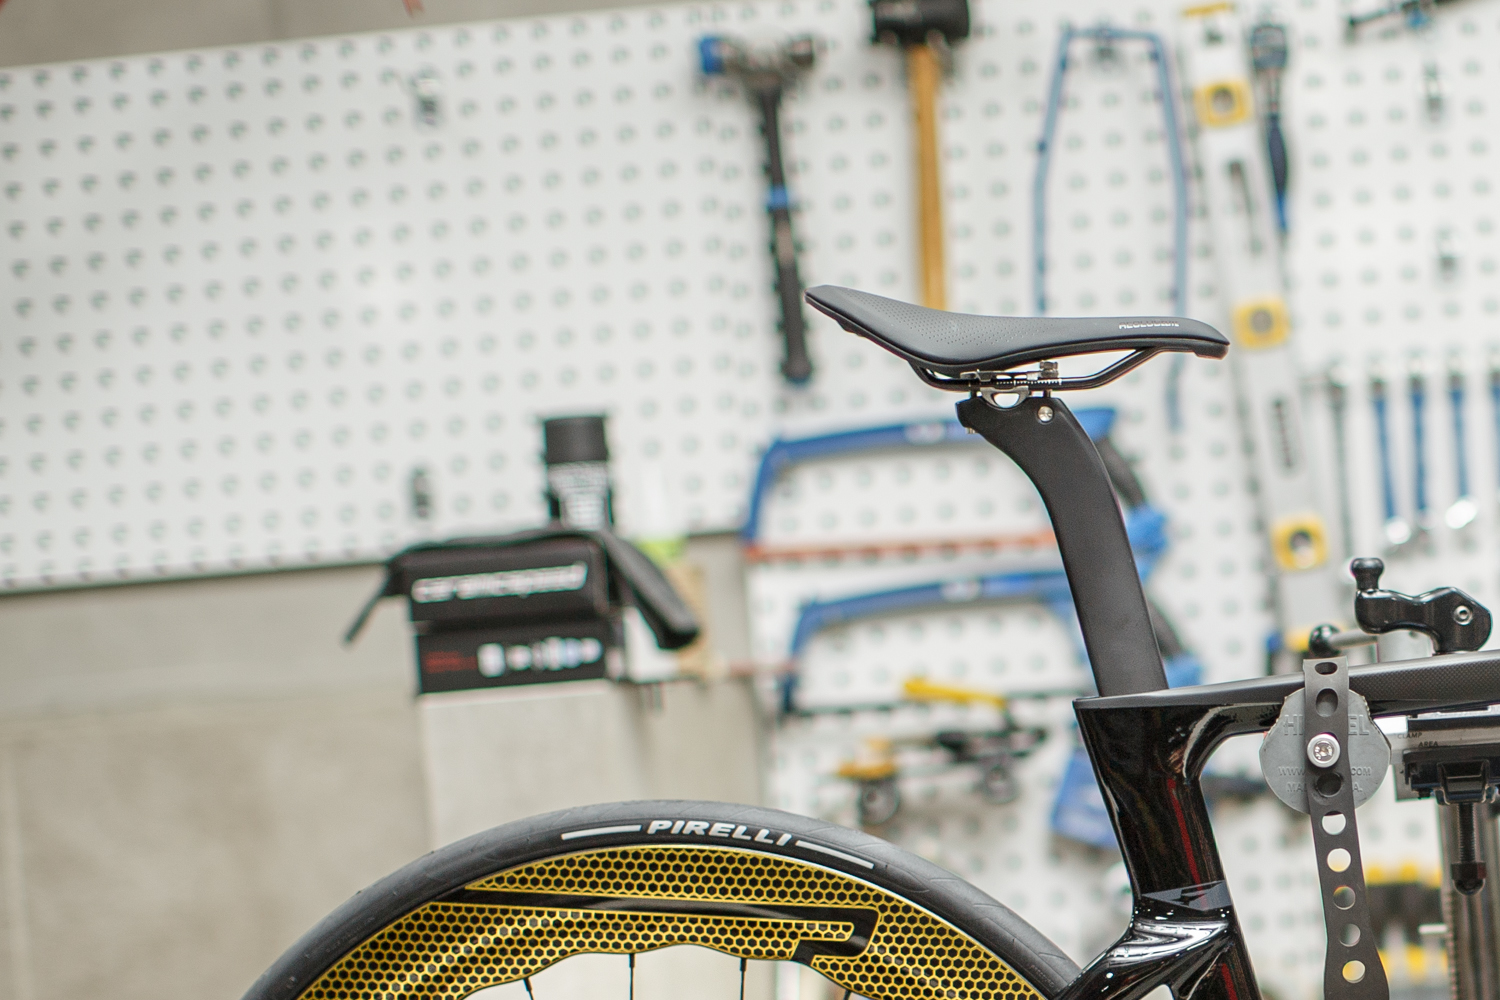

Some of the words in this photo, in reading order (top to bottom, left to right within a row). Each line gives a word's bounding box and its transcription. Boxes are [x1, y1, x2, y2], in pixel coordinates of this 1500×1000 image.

[1397, 731, 1423, 740] CLAMP
[1418, 740, 1439, 748] AREA
[647, 819, 794, 847] PIRELLI
